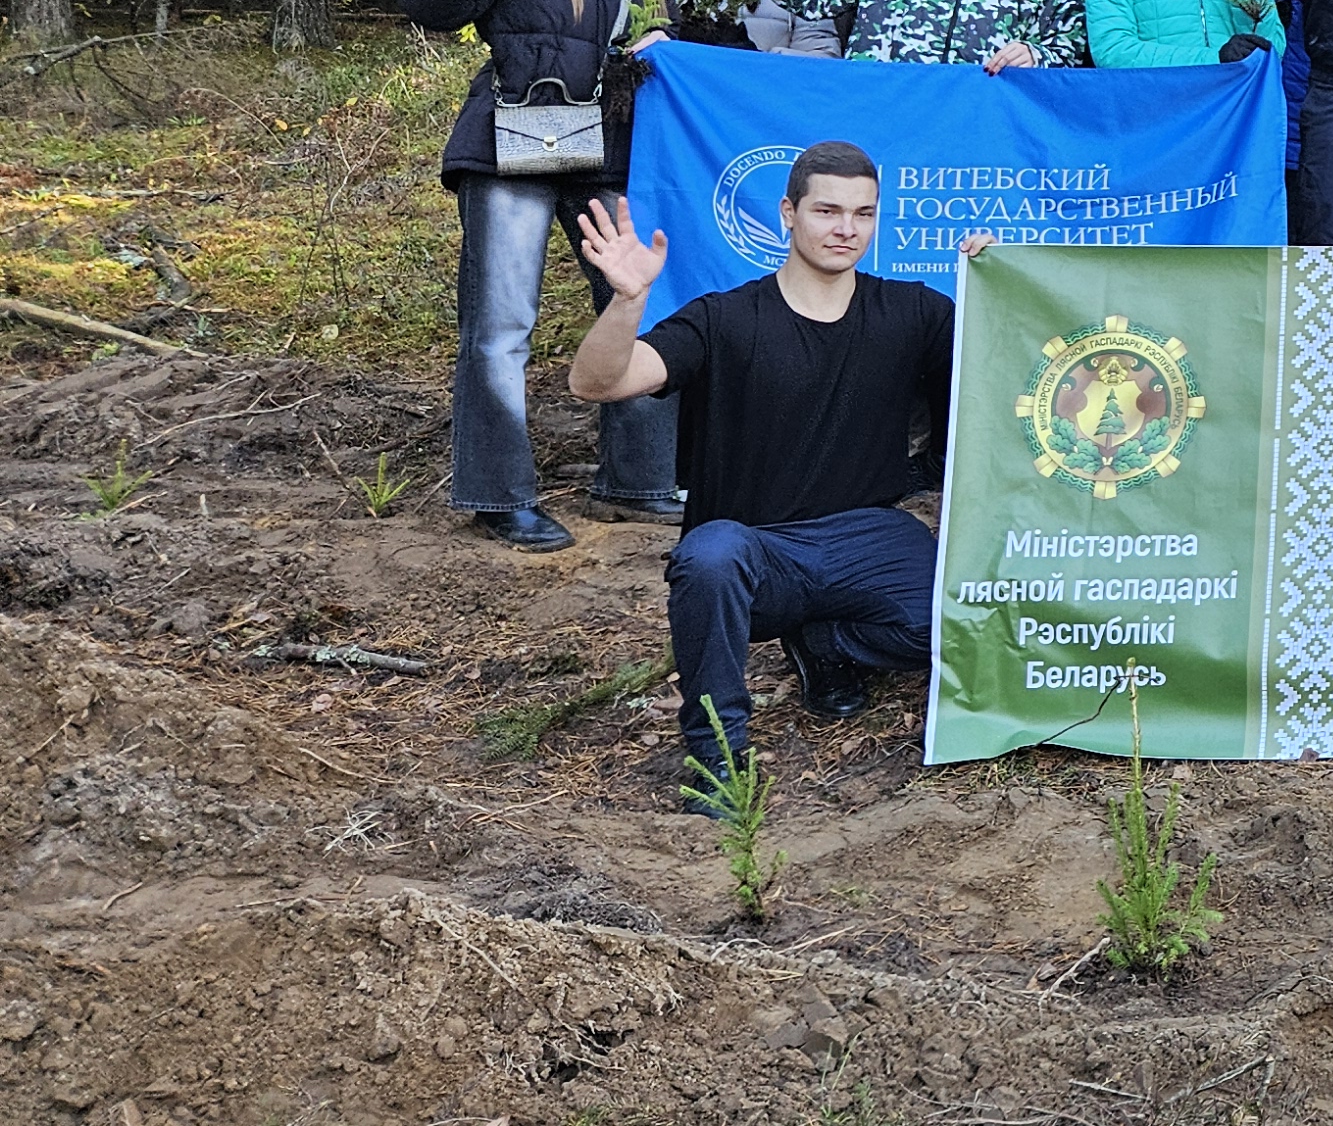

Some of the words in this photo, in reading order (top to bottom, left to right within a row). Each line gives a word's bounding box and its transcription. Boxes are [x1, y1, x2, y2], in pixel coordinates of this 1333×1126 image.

[723, 149, 786, 188] DOCENDO
[897, 163, 1112, 191] ВИТЕБСКИЙ
[896, 171, 1239, 221] ГОСУДАРСТВЕННЫЙ
[892, 262, 950, 273] ИМЕНИ
[1040, 372, 1058, 431] МІНІСТЭРСТВА
[1055, 343, 1088, 372] ЛЯСНОЙ
[1090, 337, 1143, 349] ГАСПАДАРКІ
[1144, 345, 1181, 384] РЭСПУБЛІКІ
[1169, 386, 1183, 431] БЕЛАРУСЬ
[1005, 529, 1198, 563] Міністэрства
[956, 572, 1065, 603] лясной
[1073, 570, 1238, 605] гаспадаркі
[1018, 615, 1176, 651] Рэспублікі
[1025, 660, 1167, 694] Беларусь
